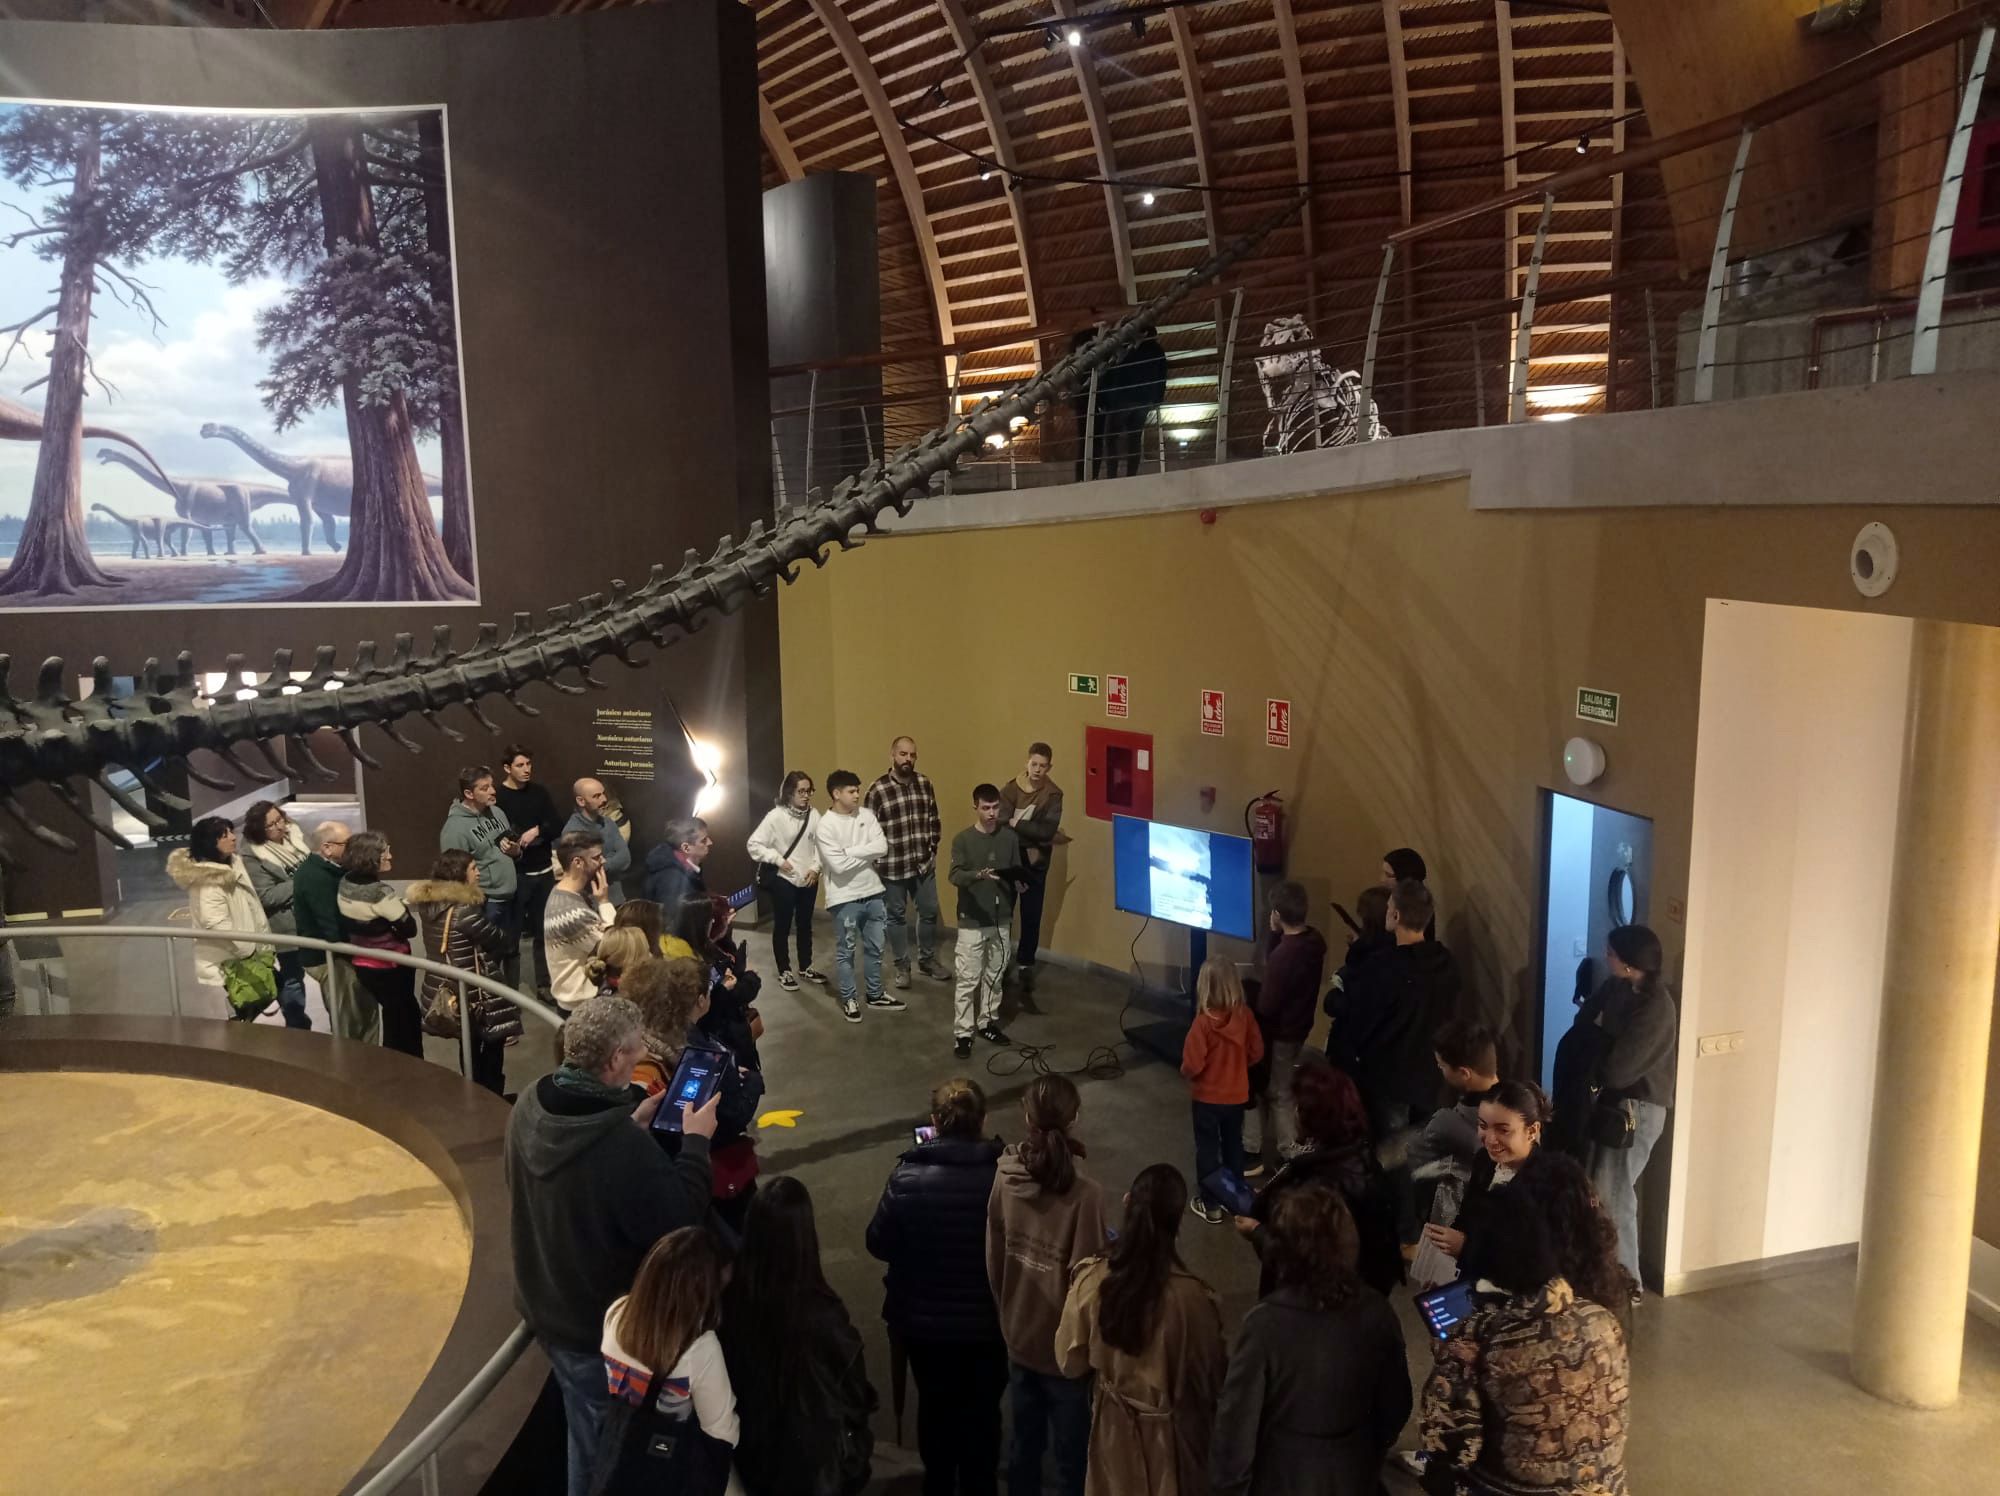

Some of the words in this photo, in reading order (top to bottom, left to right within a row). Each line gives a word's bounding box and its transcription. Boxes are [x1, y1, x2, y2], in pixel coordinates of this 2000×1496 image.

[1584, 693, 1603, 706] SALIDA
[1604, 697, 1612, 707] DE
[472, 817, 506, 842] MIAMI
